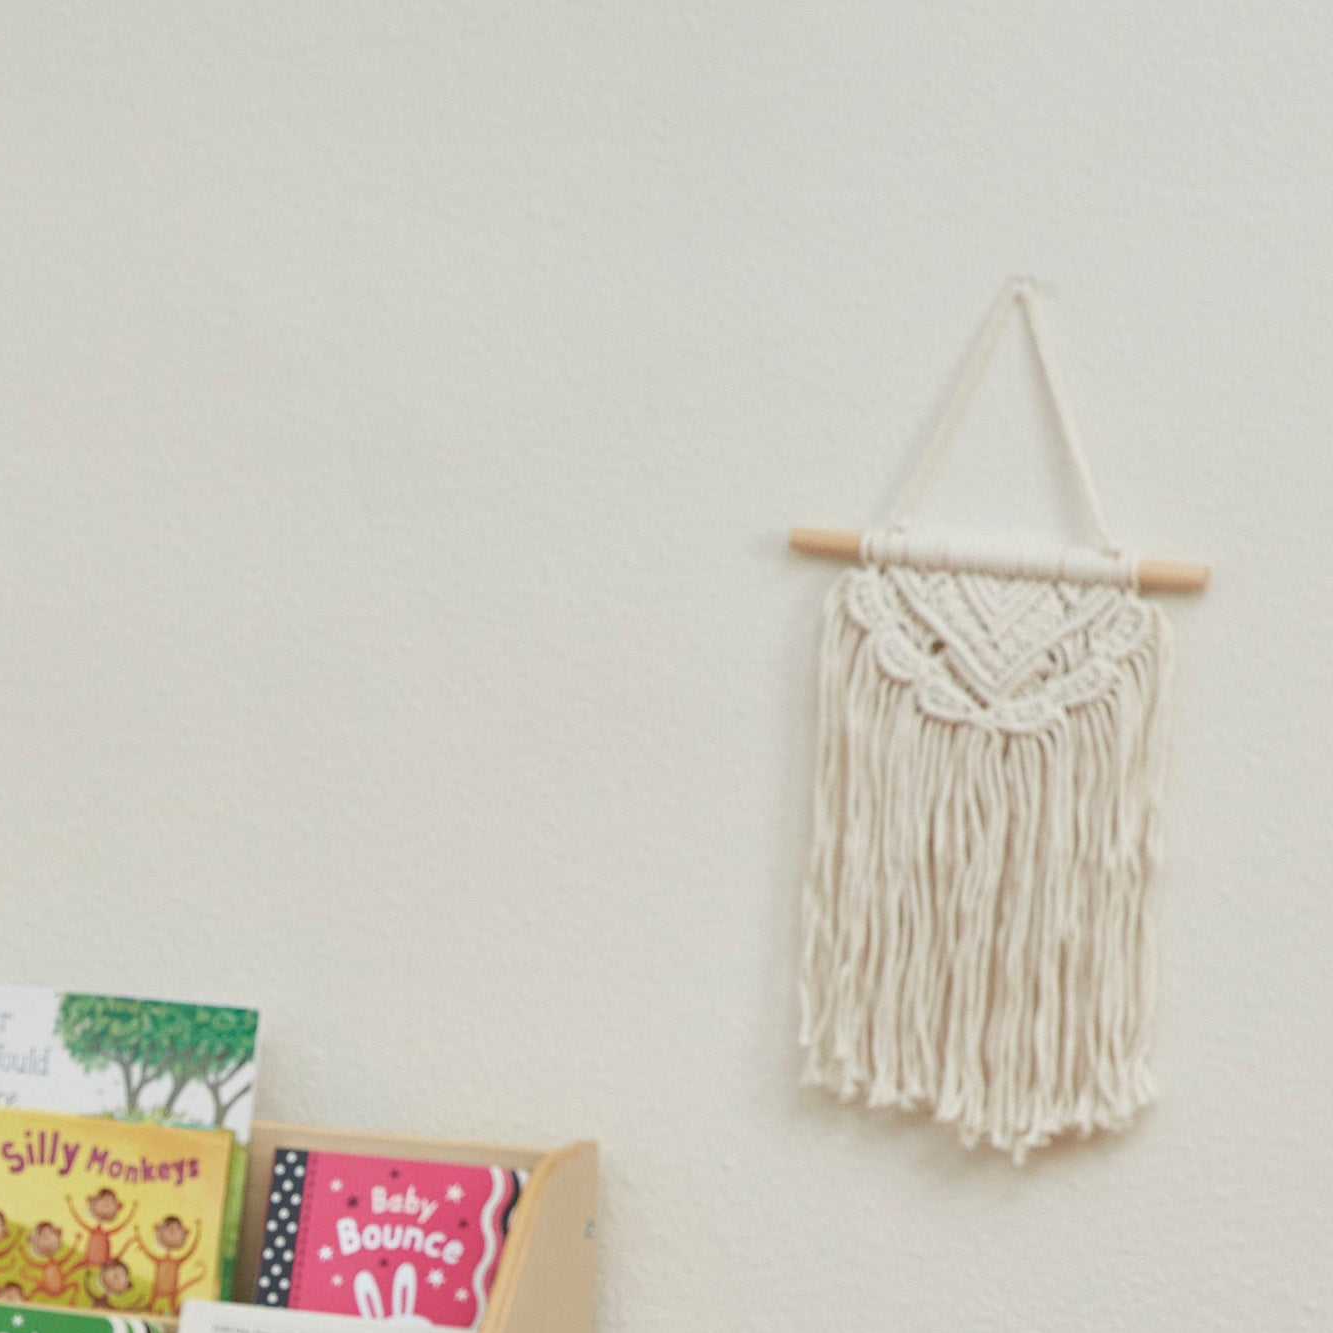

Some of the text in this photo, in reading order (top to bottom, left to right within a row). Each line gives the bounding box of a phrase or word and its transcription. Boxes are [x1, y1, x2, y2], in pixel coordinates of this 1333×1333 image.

[0, 1130, 81, 1177] Silly
[85, 1145, 200, 1186] Monkeys
[369, 1183, 439, 1224] Baby
[335, 1217, 466, 1266] Bounce
